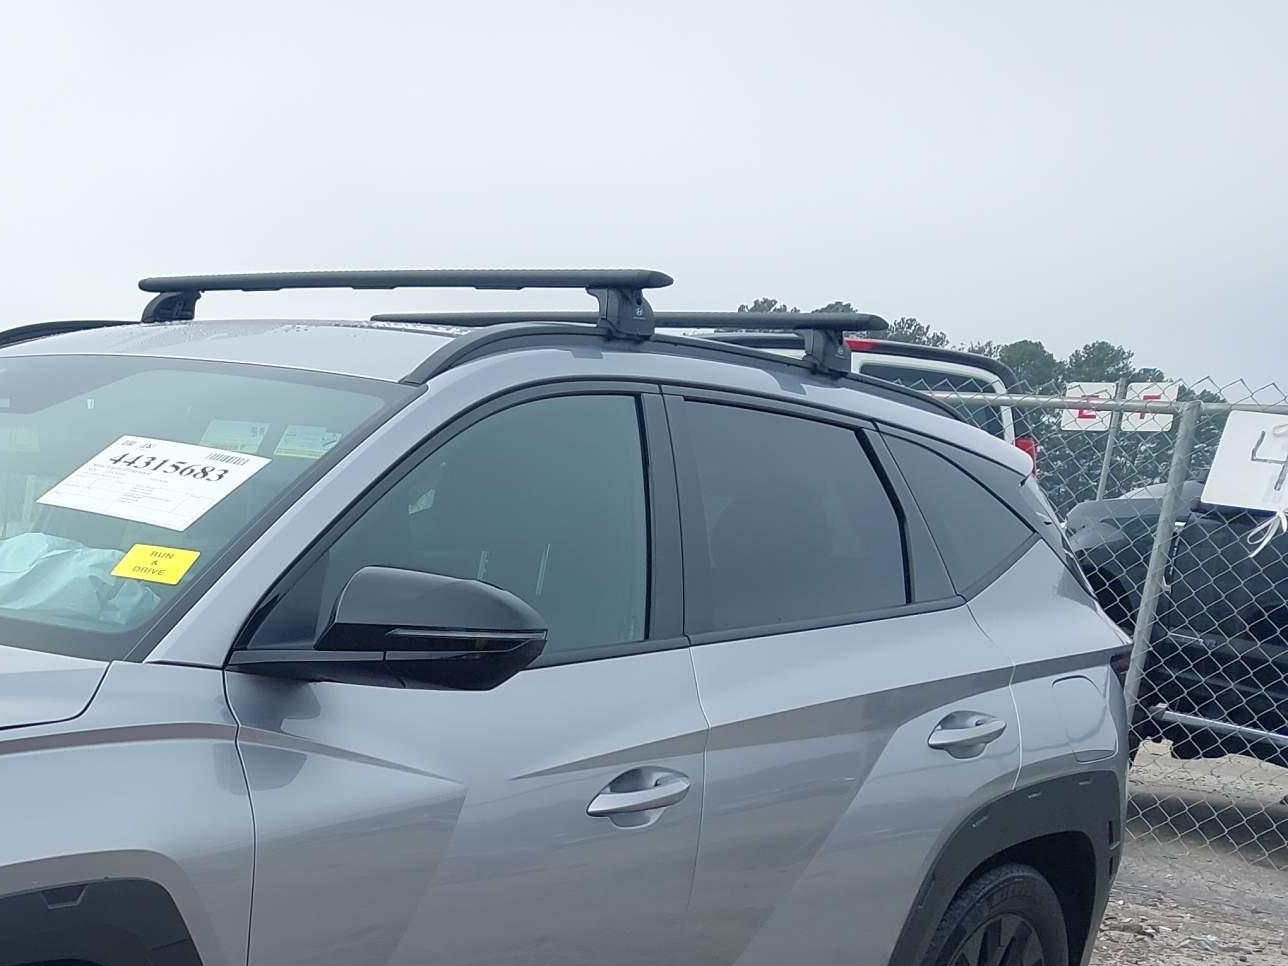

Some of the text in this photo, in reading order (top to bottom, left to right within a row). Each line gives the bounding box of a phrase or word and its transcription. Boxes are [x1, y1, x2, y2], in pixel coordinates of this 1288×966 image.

[109, 451, 229, 482] 44315683
[149, 551, 175, 560] RUN
[132, 565, 167, 577] DRIVE
